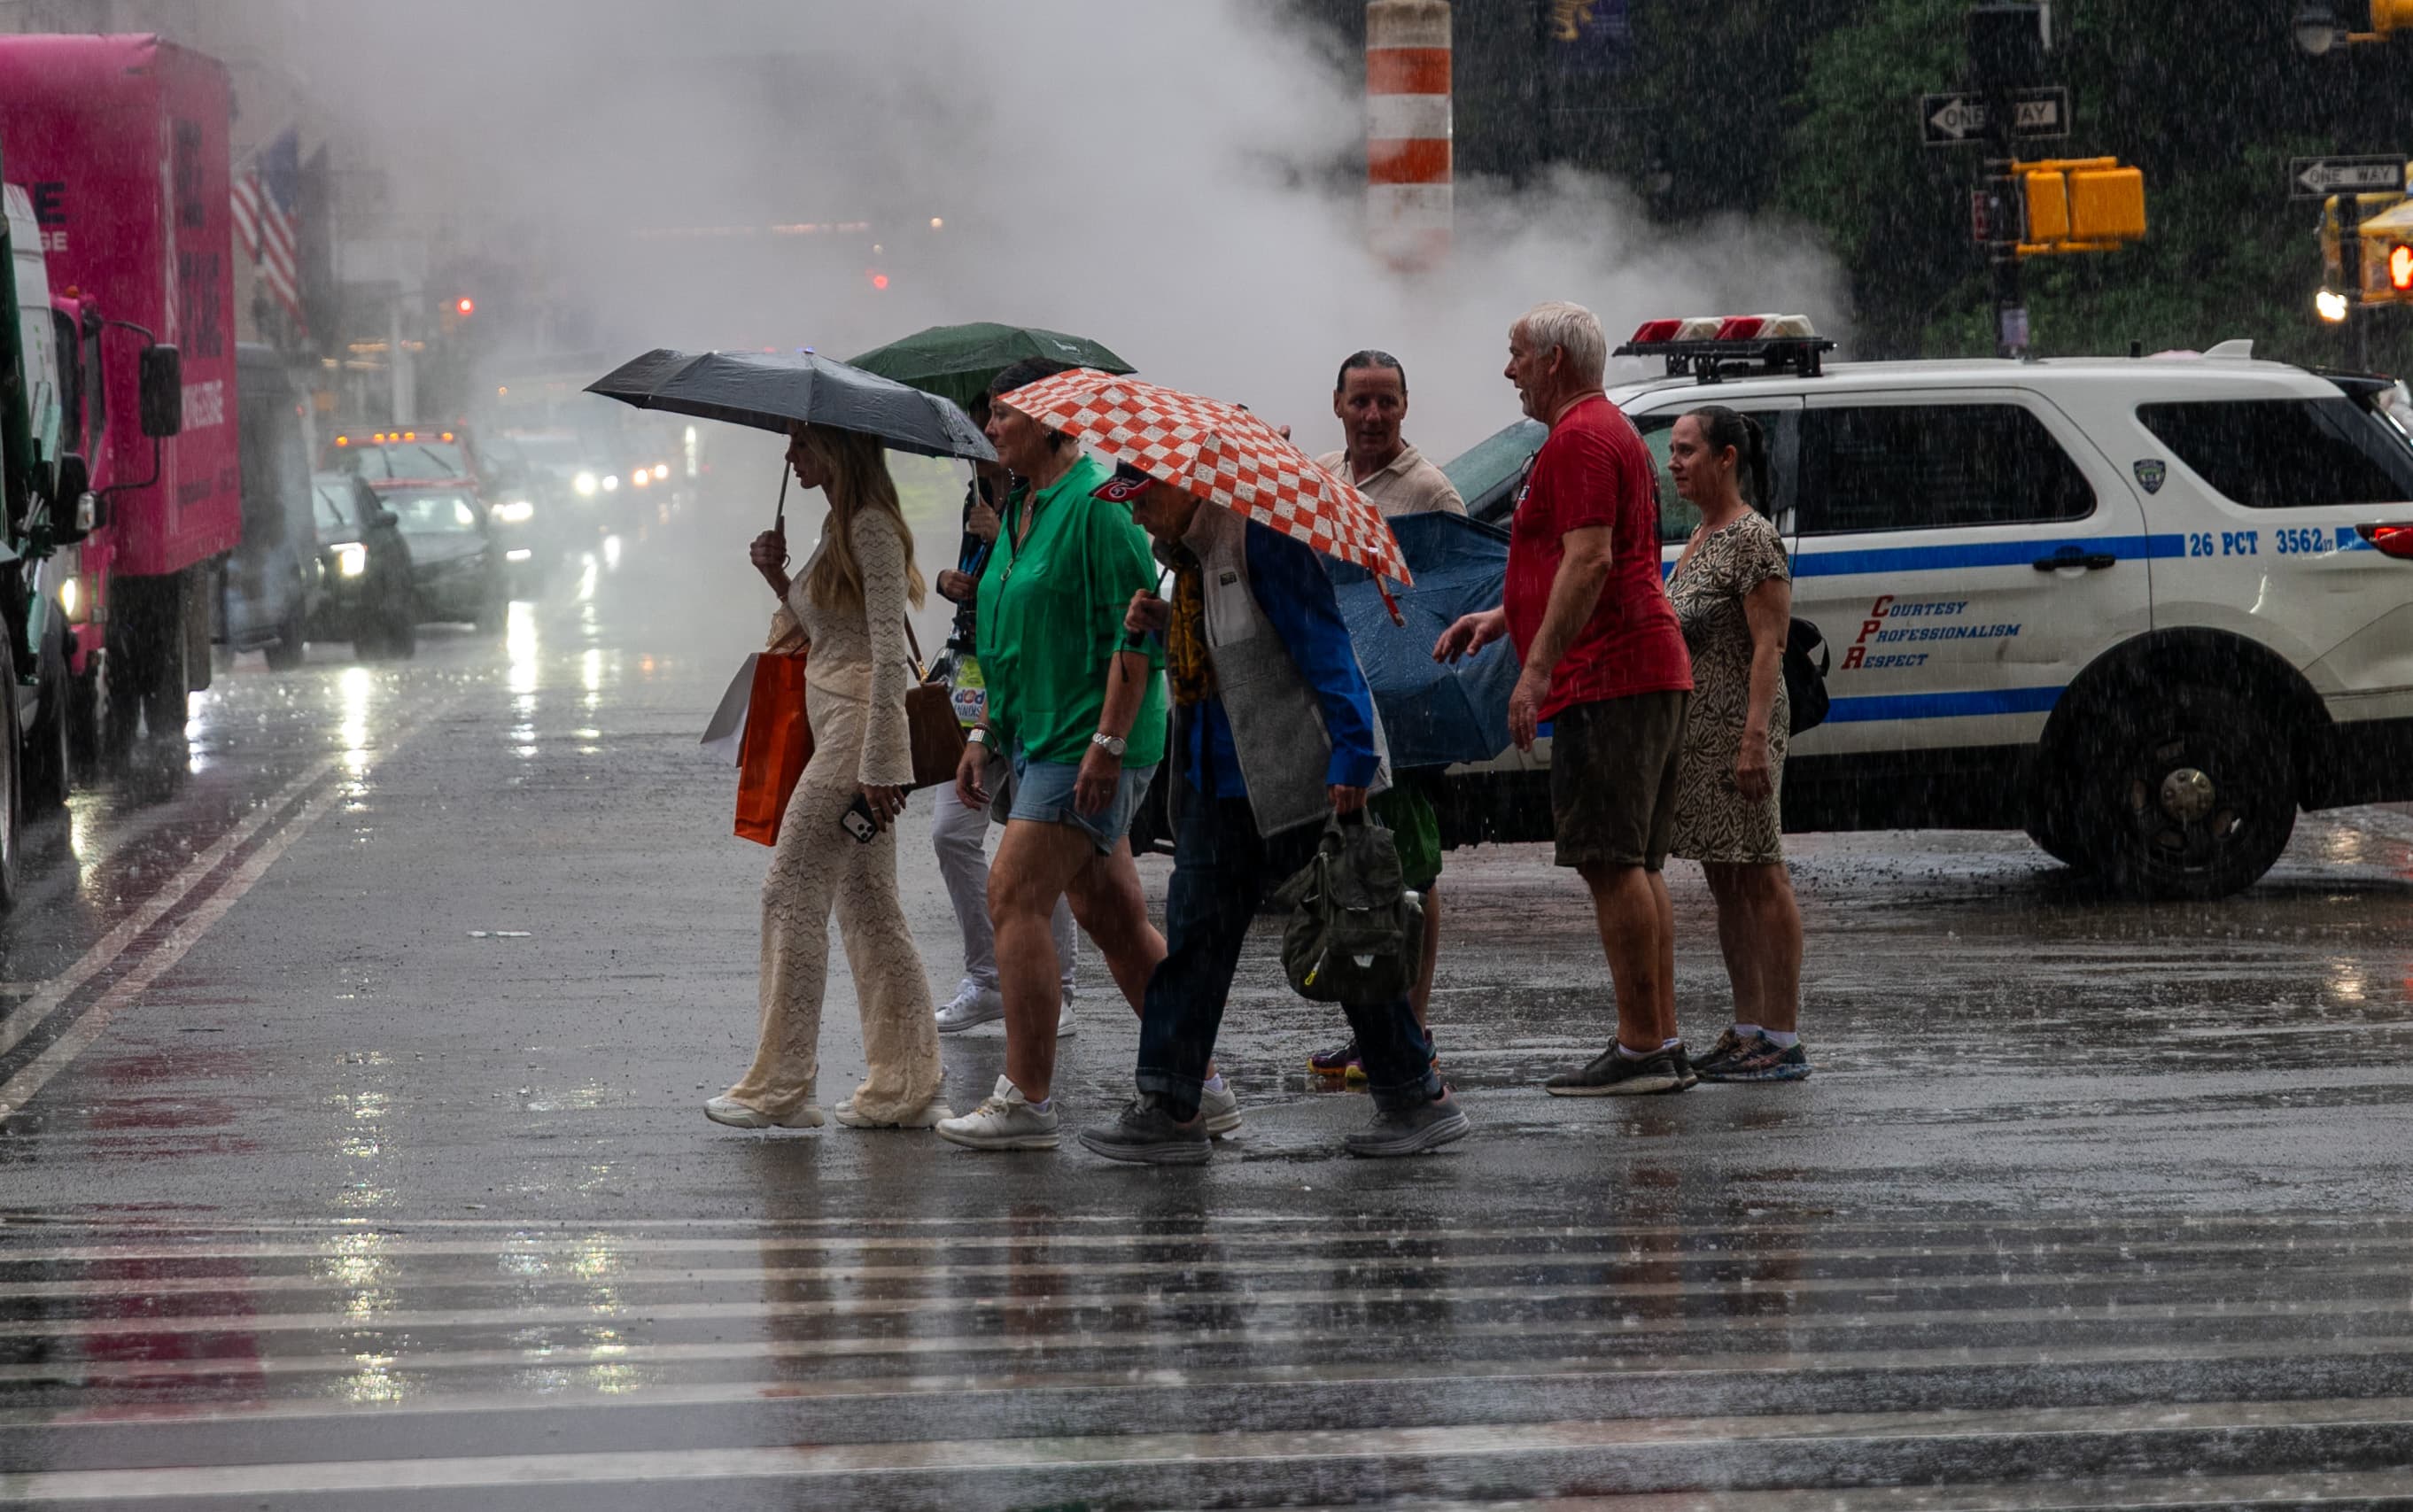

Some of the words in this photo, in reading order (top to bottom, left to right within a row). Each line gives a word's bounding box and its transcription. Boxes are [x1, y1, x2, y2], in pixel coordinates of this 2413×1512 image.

[1945, 106, 1985, 128] ONE
[2017, 104, 2048, 122] AY
[2310, 168, 2342, 183] ONE
[2356, 167, 2390, 182] WAY
[2190, 533, 2214, 557] 26
[2221, 531, 2258, 555] PCT
[2276, 527, 2323, 554] 3562
[1871, 595, 1968, 617] COURTESY
[1856, 620, 2021, 644] PROFESSIONALISM
[1841, 647, 1928, 671] RESPECT
